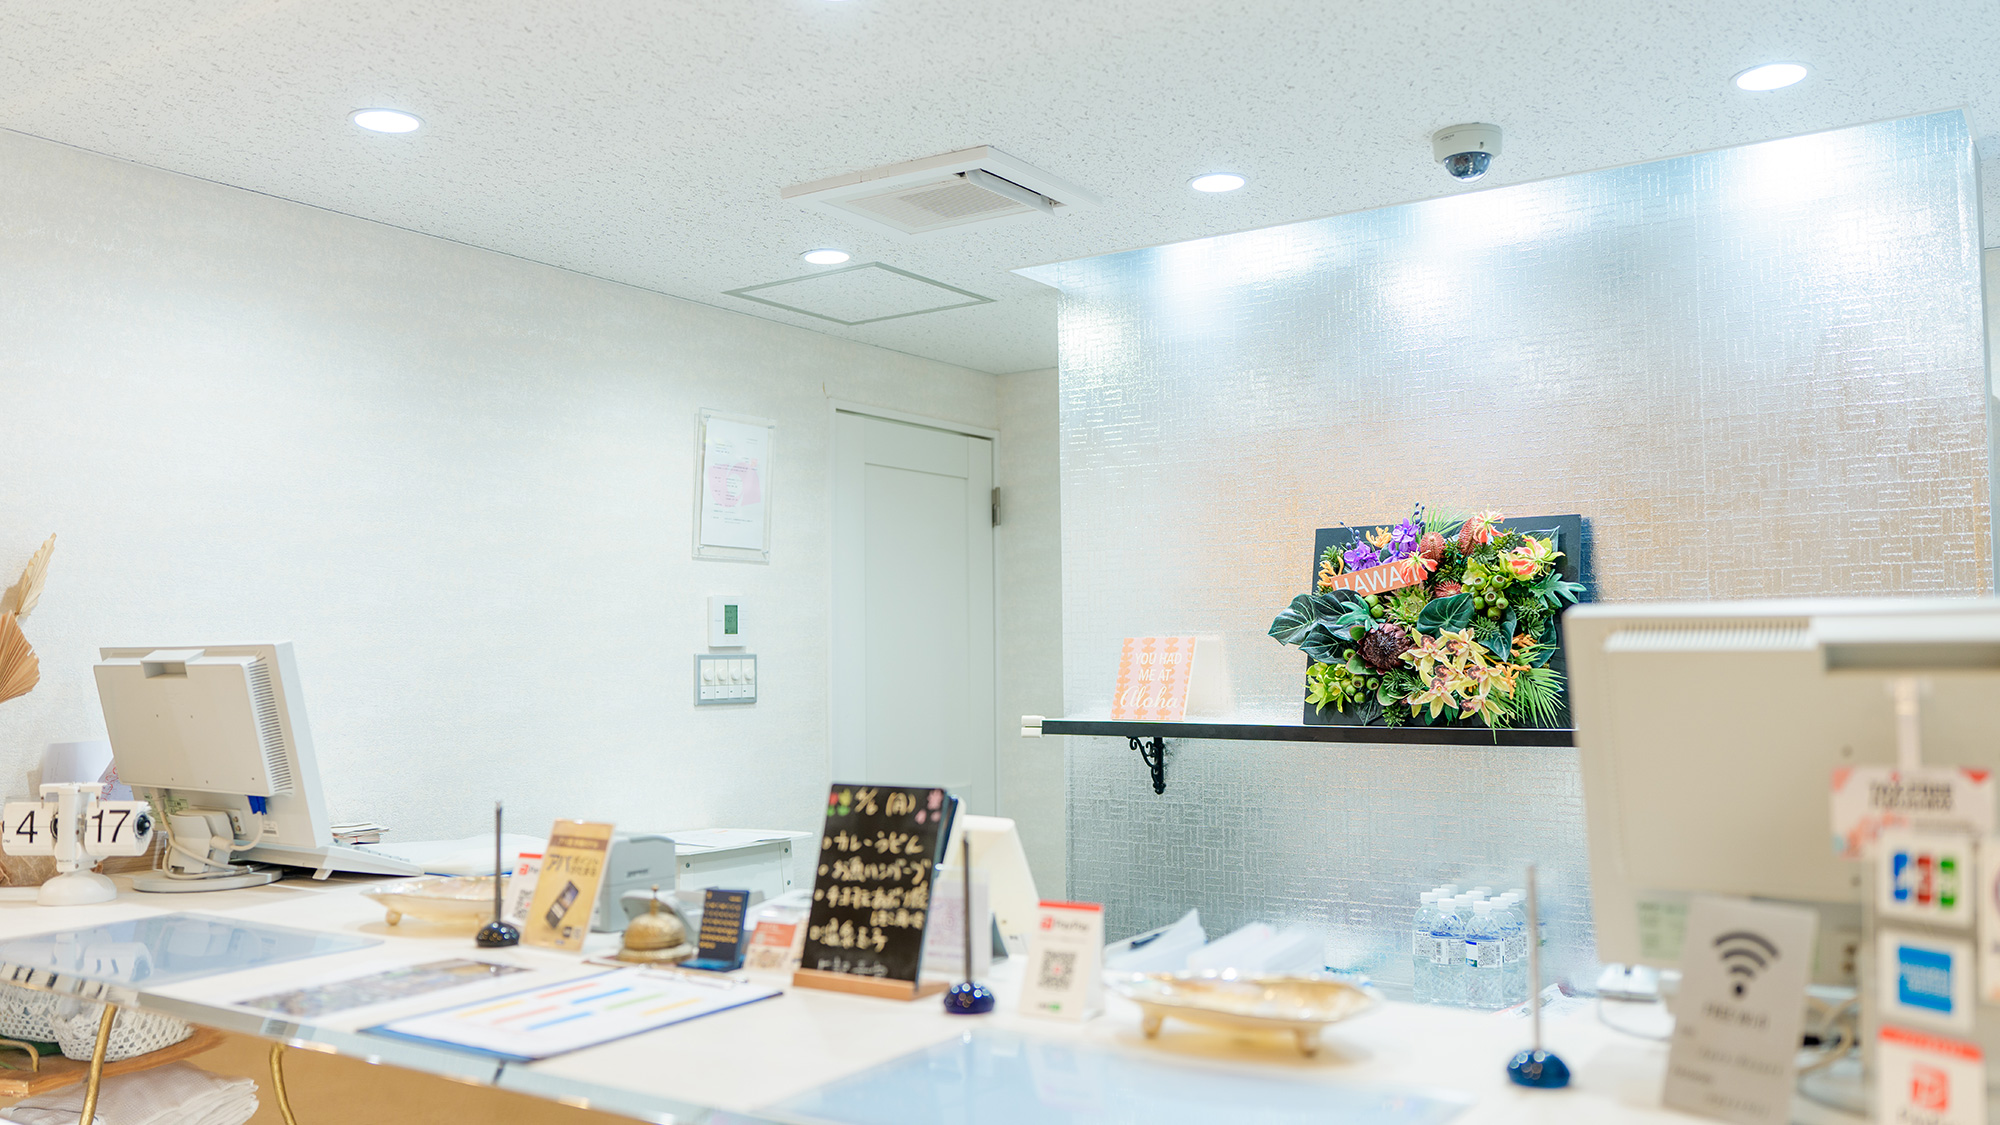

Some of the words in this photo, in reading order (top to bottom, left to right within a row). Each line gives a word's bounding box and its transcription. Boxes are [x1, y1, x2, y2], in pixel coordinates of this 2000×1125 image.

[1334, 566, 1418, 593] HAWAI
[1135, 653, 1157, 665] YOU
[1159, 653, 1182, 665] HAD
[1138, 669, 1156, 681] ME
[1158, 669, 1172, 681] AT
[1120, 685, 1179, 708] Aloha
[16, 811, 38, 844] 4
[91, 809, 131, 843] 17
